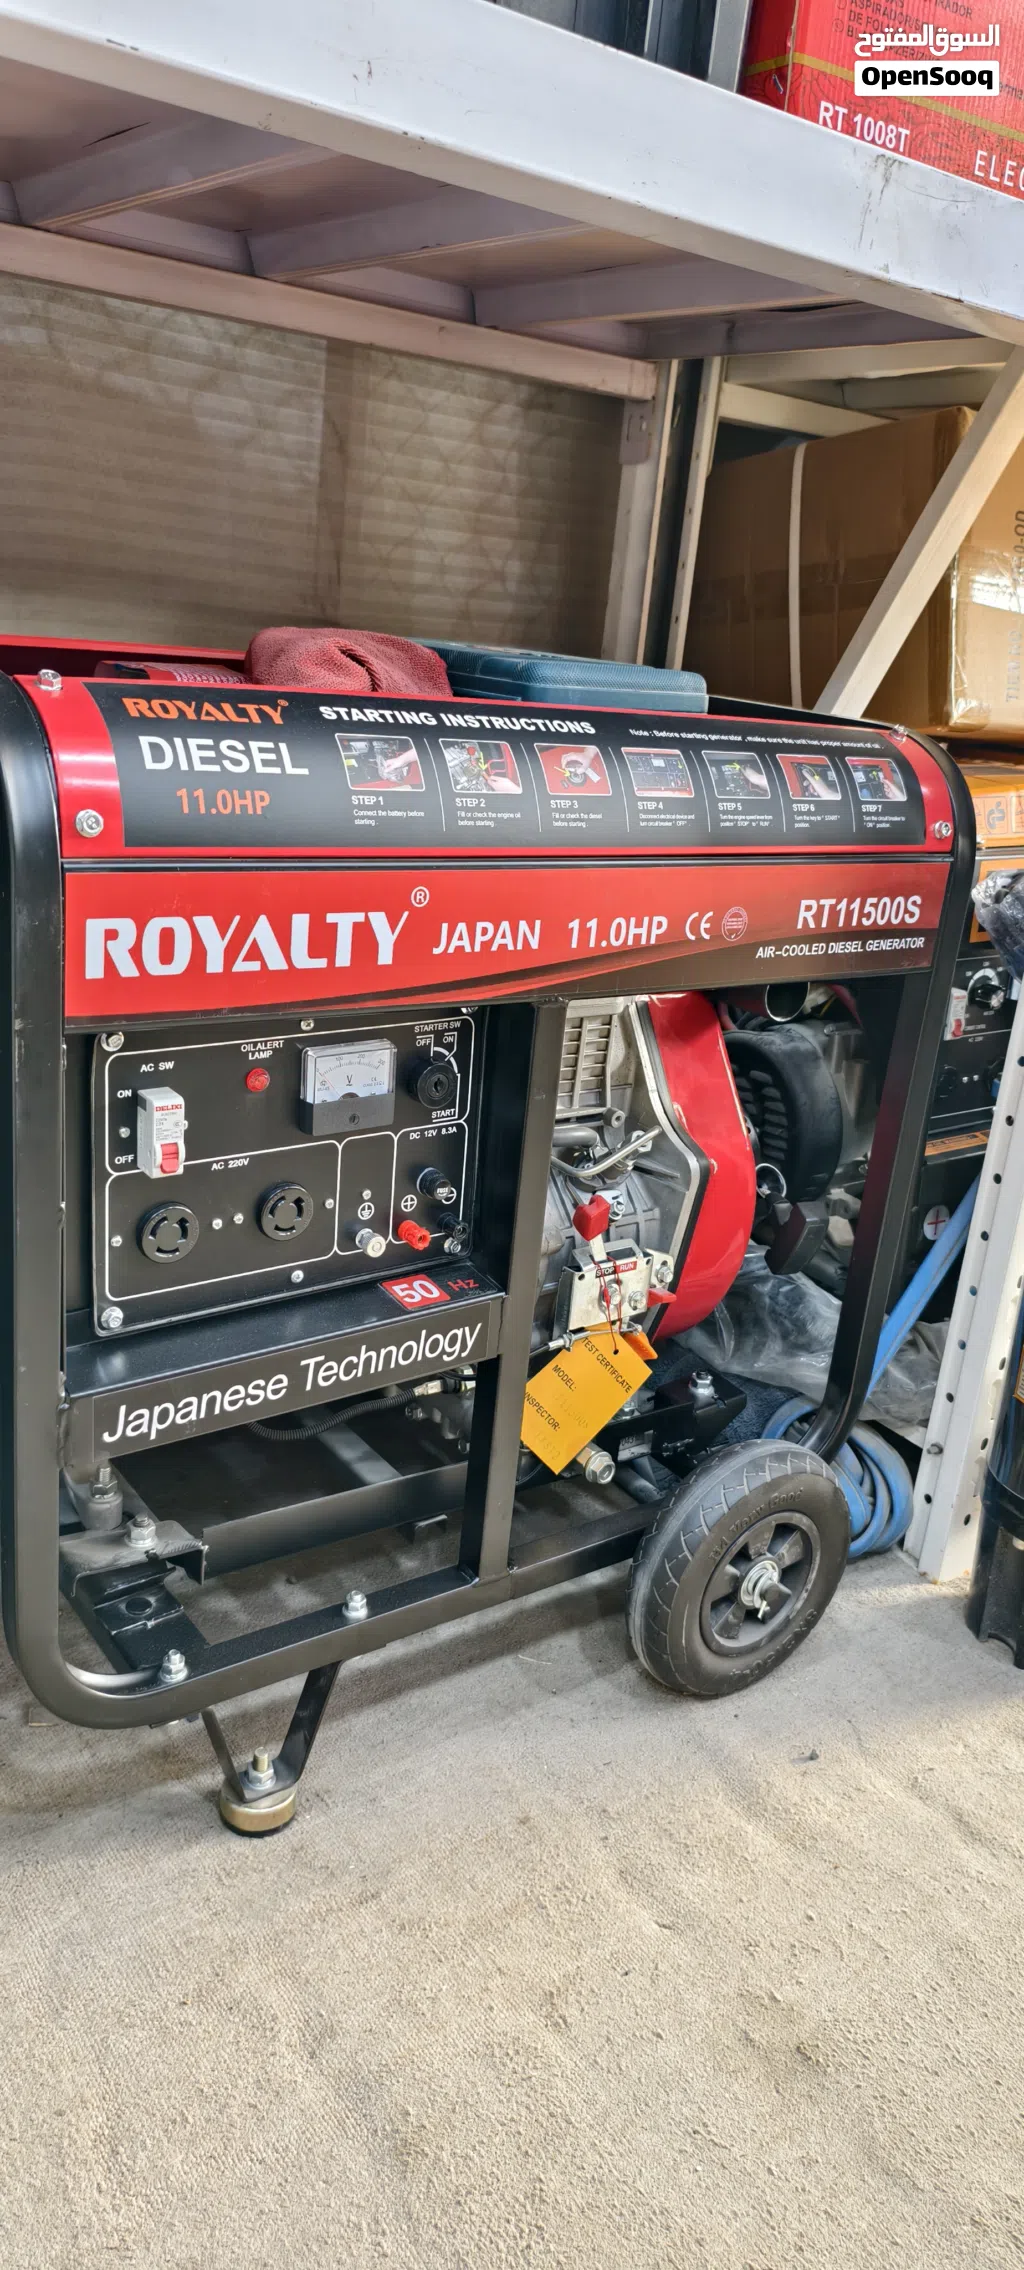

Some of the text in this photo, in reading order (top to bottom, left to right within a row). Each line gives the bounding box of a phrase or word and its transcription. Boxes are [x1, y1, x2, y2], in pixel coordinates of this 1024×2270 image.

[818, 100, 911, 153] RT 1008T
[121, 697, 284, 725] ROYALTY
[318, 705, 596, 735] STARTING INSTRUCTIONS
[652, 730, 680, 739] Before
[680, 732, 709, 741] starting
[708, 734, 743, 742] generator
[138, 735, 310, 775] DIESEL
[176, 788, 271, 815] 11.0HP
[351, 795, 384, 806] STEP 1
[455, 798, 486, 807] STEP 2
[550, 800, 579, 809] STEP 3
[637, 801, 664, 810] STEP 4
[717, 802, 743, 811] STEP 5
[792, 803, 816, 812] STEP 6
[861, 804, 878, 812] STEP
[353, 809, 377, 817] Connect
[387, 810, 407, 819] battery
[407, 810, 425, 818] before
[472, 811, 488, 819] check
[796, 895, 922, 930] RT11500S
[85, 910, 409, 980] ROYALTY
[432, 919, 542, 955] JAPAN
[567, 915, 669, 949] 11.0HP
[755, 937, 925, 959] AIR-COOLED DIESEL GENERATOR
[414, 1020, 461, 1033] STARTER SW
[415, 1038, 431, 1047] OFF
[442, 1035, 454, 1043] ON
[240, 1040, 284, 1052] OIL ALERT
[248, 1050, 273, 1060] LAMP
[140, 1061, 175, 1073] AC SW
[117, 1089, 132, 1099] ON
[155, 1104, 183, 1113] DELIXI
[431, 1108, 456, 1118] START
[409, 1126, 458, 1140] DC 12V 8.3A
[114, 1154, 135, 1165] OFF
[211, 1158, 250, 1171] AC 220V
[596, 1263, 635, 1277] STOP RUN
[391, 1279, 480, 1303] 50 Hz
[581, 1336, 633, 1394] TEST CERTIFICATE
[101, 1322, 483, 1443] Japanese Technology
[551, 1364, 577, 1392] MODEL:
